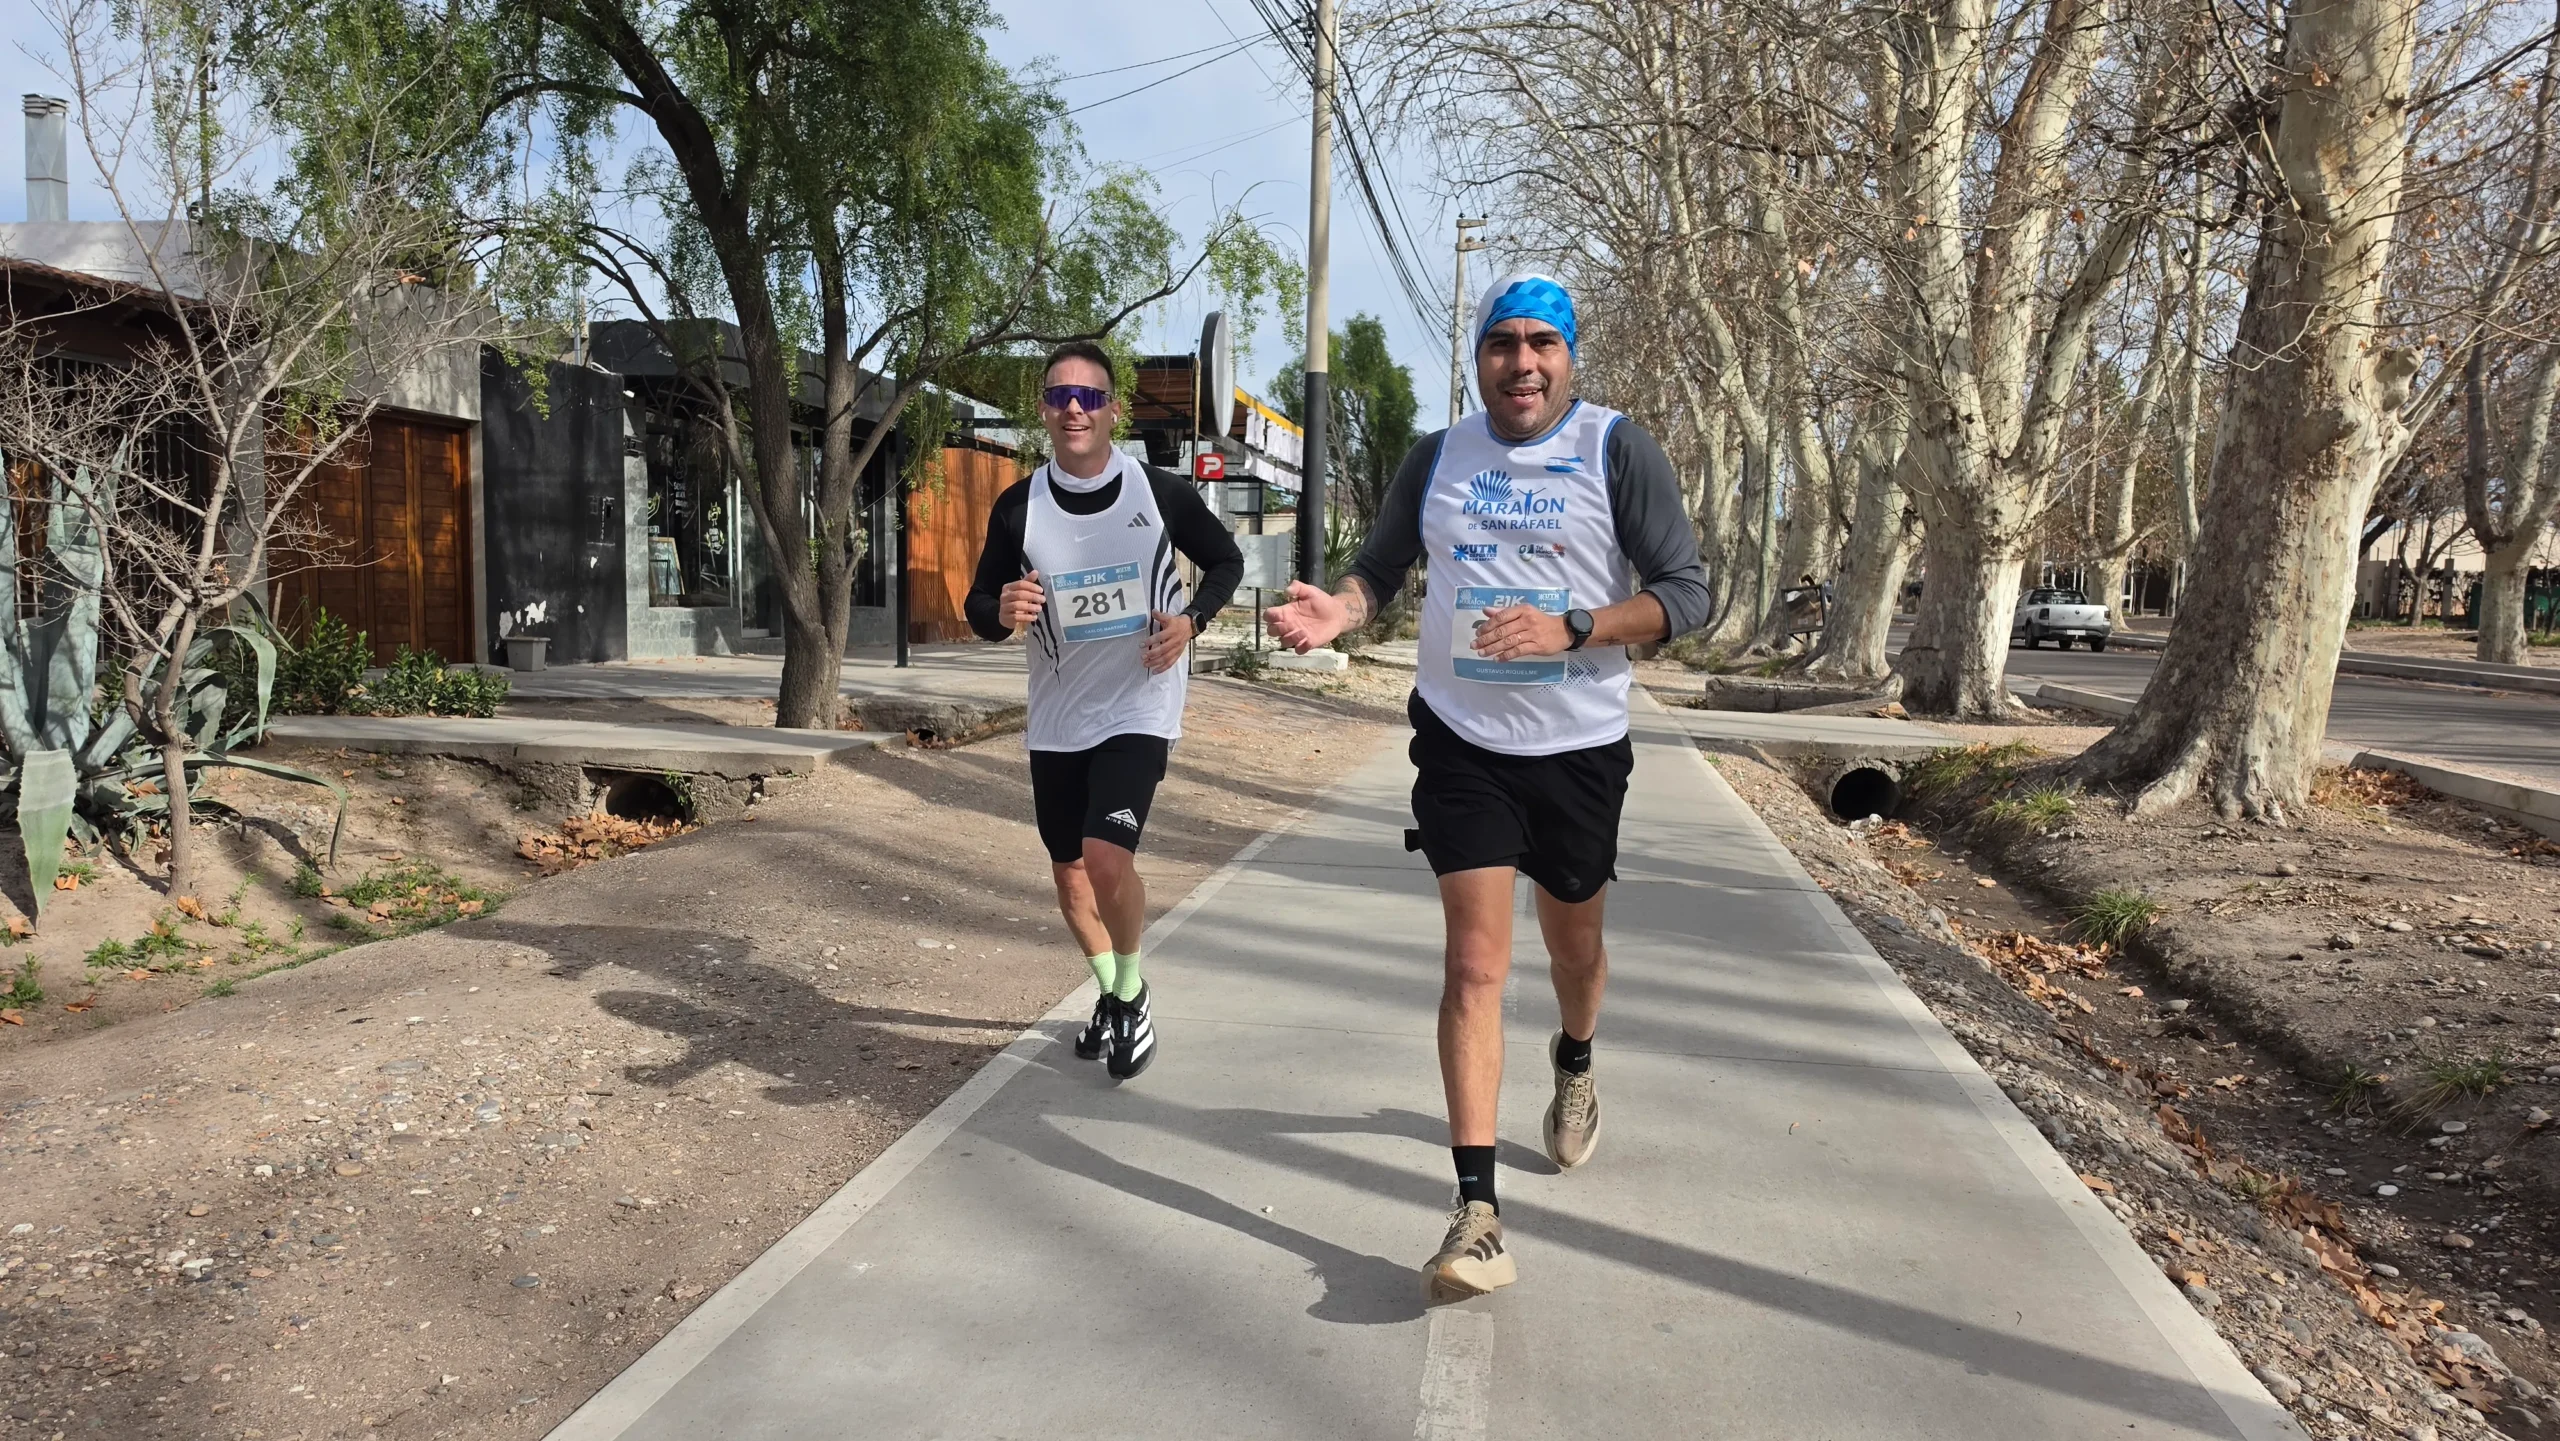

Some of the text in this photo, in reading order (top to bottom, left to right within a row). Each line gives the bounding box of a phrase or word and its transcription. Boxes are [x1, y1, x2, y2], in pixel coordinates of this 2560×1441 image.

[1202, 456, 1222, 475] P
[1462, 493, 1565, 517] MARATON
[1480, 519, 1507, 531] SAN
[1510, 519, 1562, 530] RAFAEL
[1469, 544, 1498, 554] UTN
[1083, 572, 1106, 585] 21K
[1072, 588, 1126, 618] 281
[1493, 595, 1525, 607] 21K
